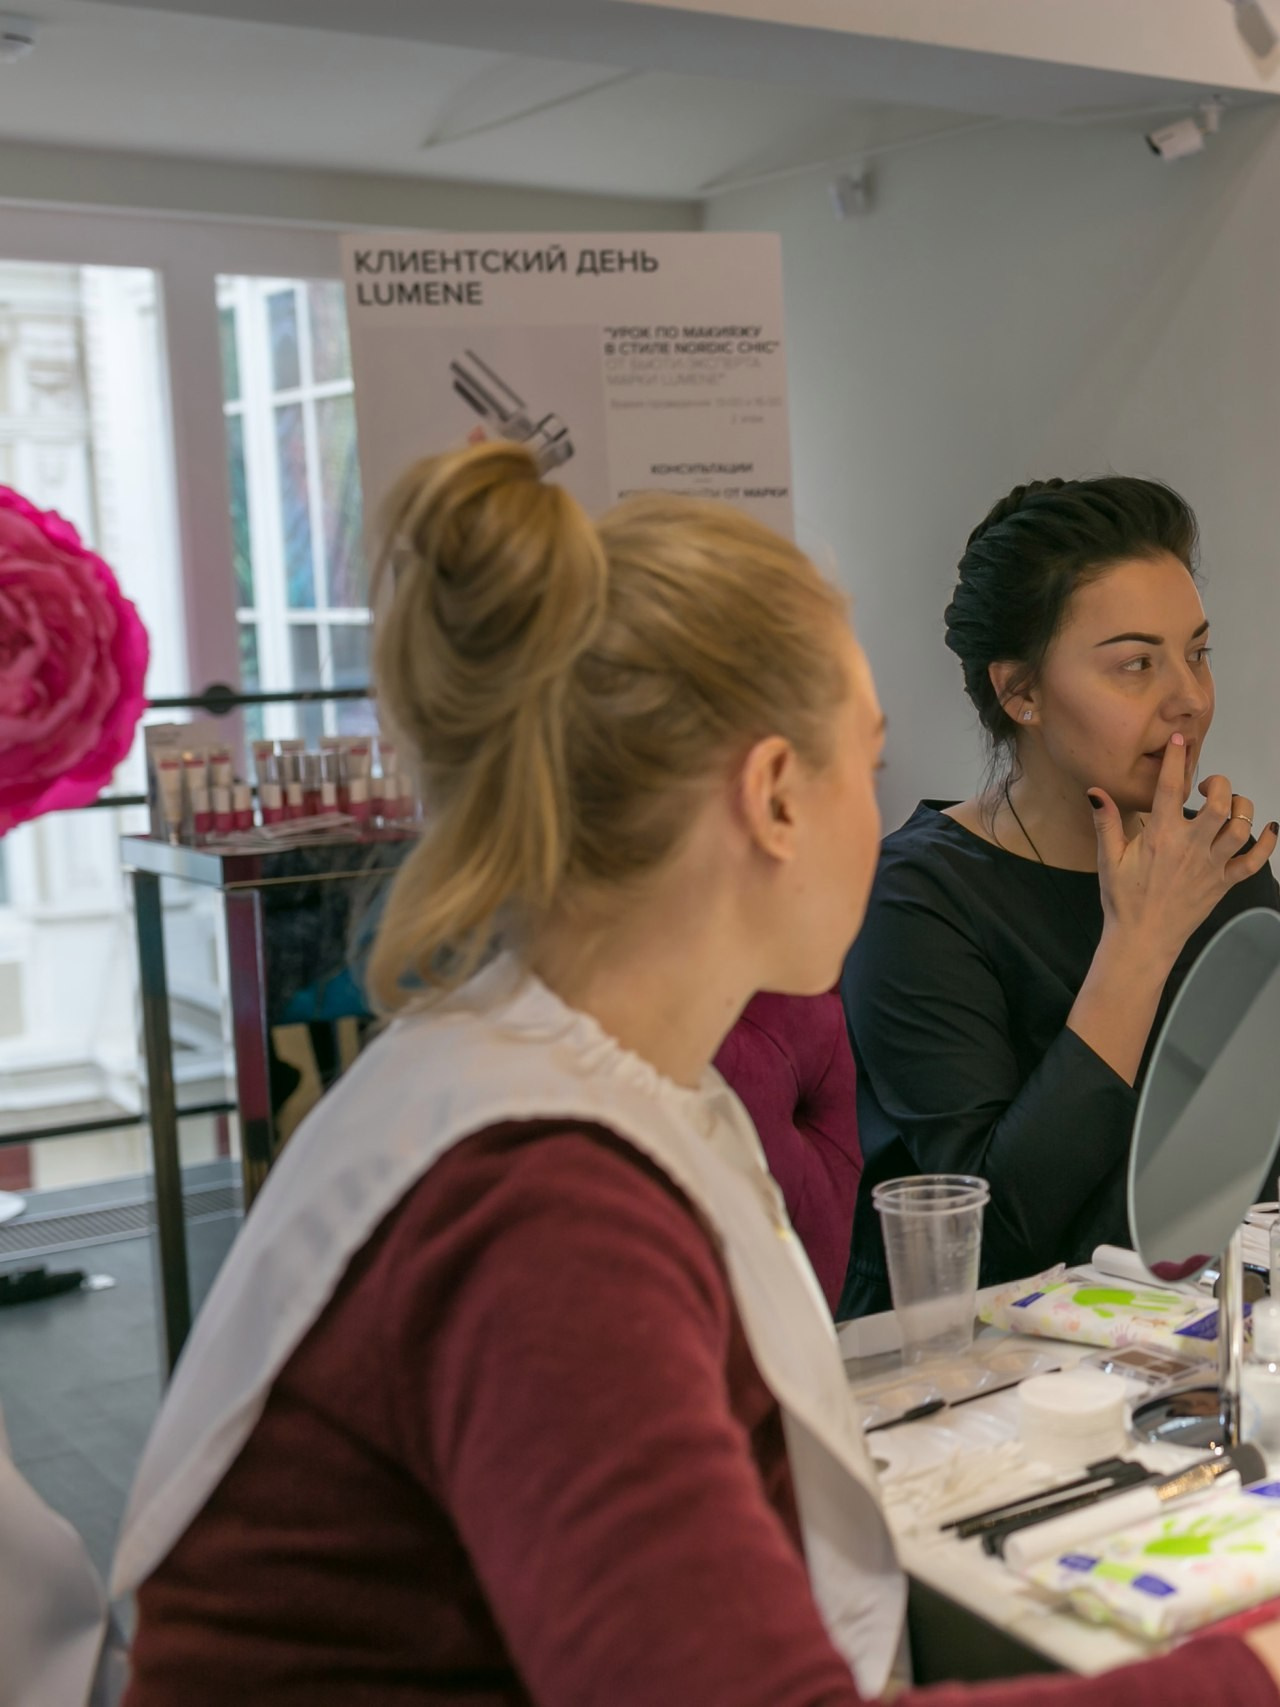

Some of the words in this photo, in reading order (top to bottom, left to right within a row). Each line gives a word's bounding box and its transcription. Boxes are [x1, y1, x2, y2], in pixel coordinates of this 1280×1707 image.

[353, 244, 568, 275] КЛИЕНТСКИЙ
[576, 248, 661, 277] ДЕНЬ
[355, 281, 484, 307] LUMENE
[654, 325, 679, 340] ПО
[603, 341, 616, 356] В
[618, 341, 670, 355] СТИЛЕ
[674, 341, 734, 354] NORDIC
